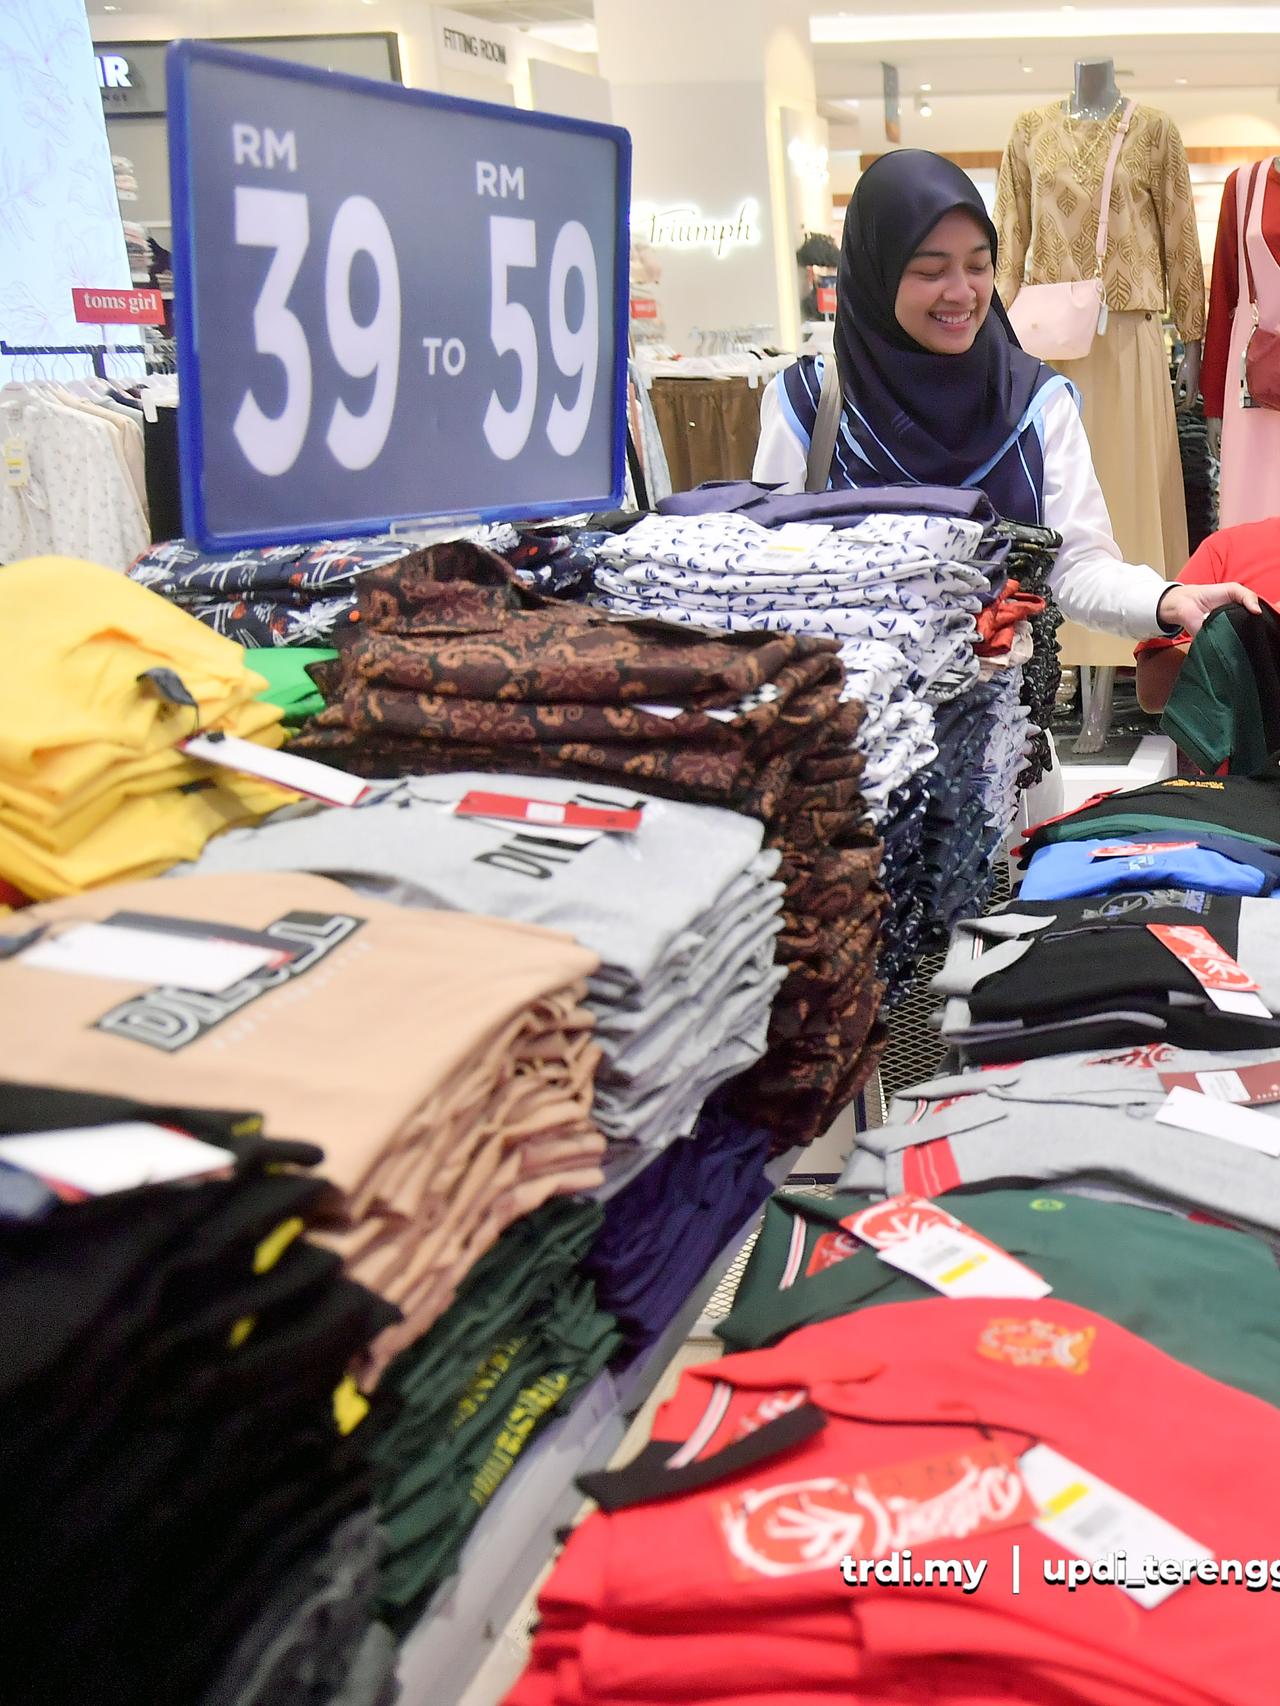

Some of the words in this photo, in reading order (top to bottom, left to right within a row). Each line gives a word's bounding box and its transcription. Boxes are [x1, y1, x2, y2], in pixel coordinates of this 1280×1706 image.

[232, 123, 297, 172] RM
[476, 160, 524, 201] RM
[647, 202, 752, 257] Triumph
[83, 292, 127, 310] toms
[128, 292, 158, 314] girl
[232, 186, 401, 476] 39
[423, 338, 466, 376] TO
[483, 215, 600, 461] 59
